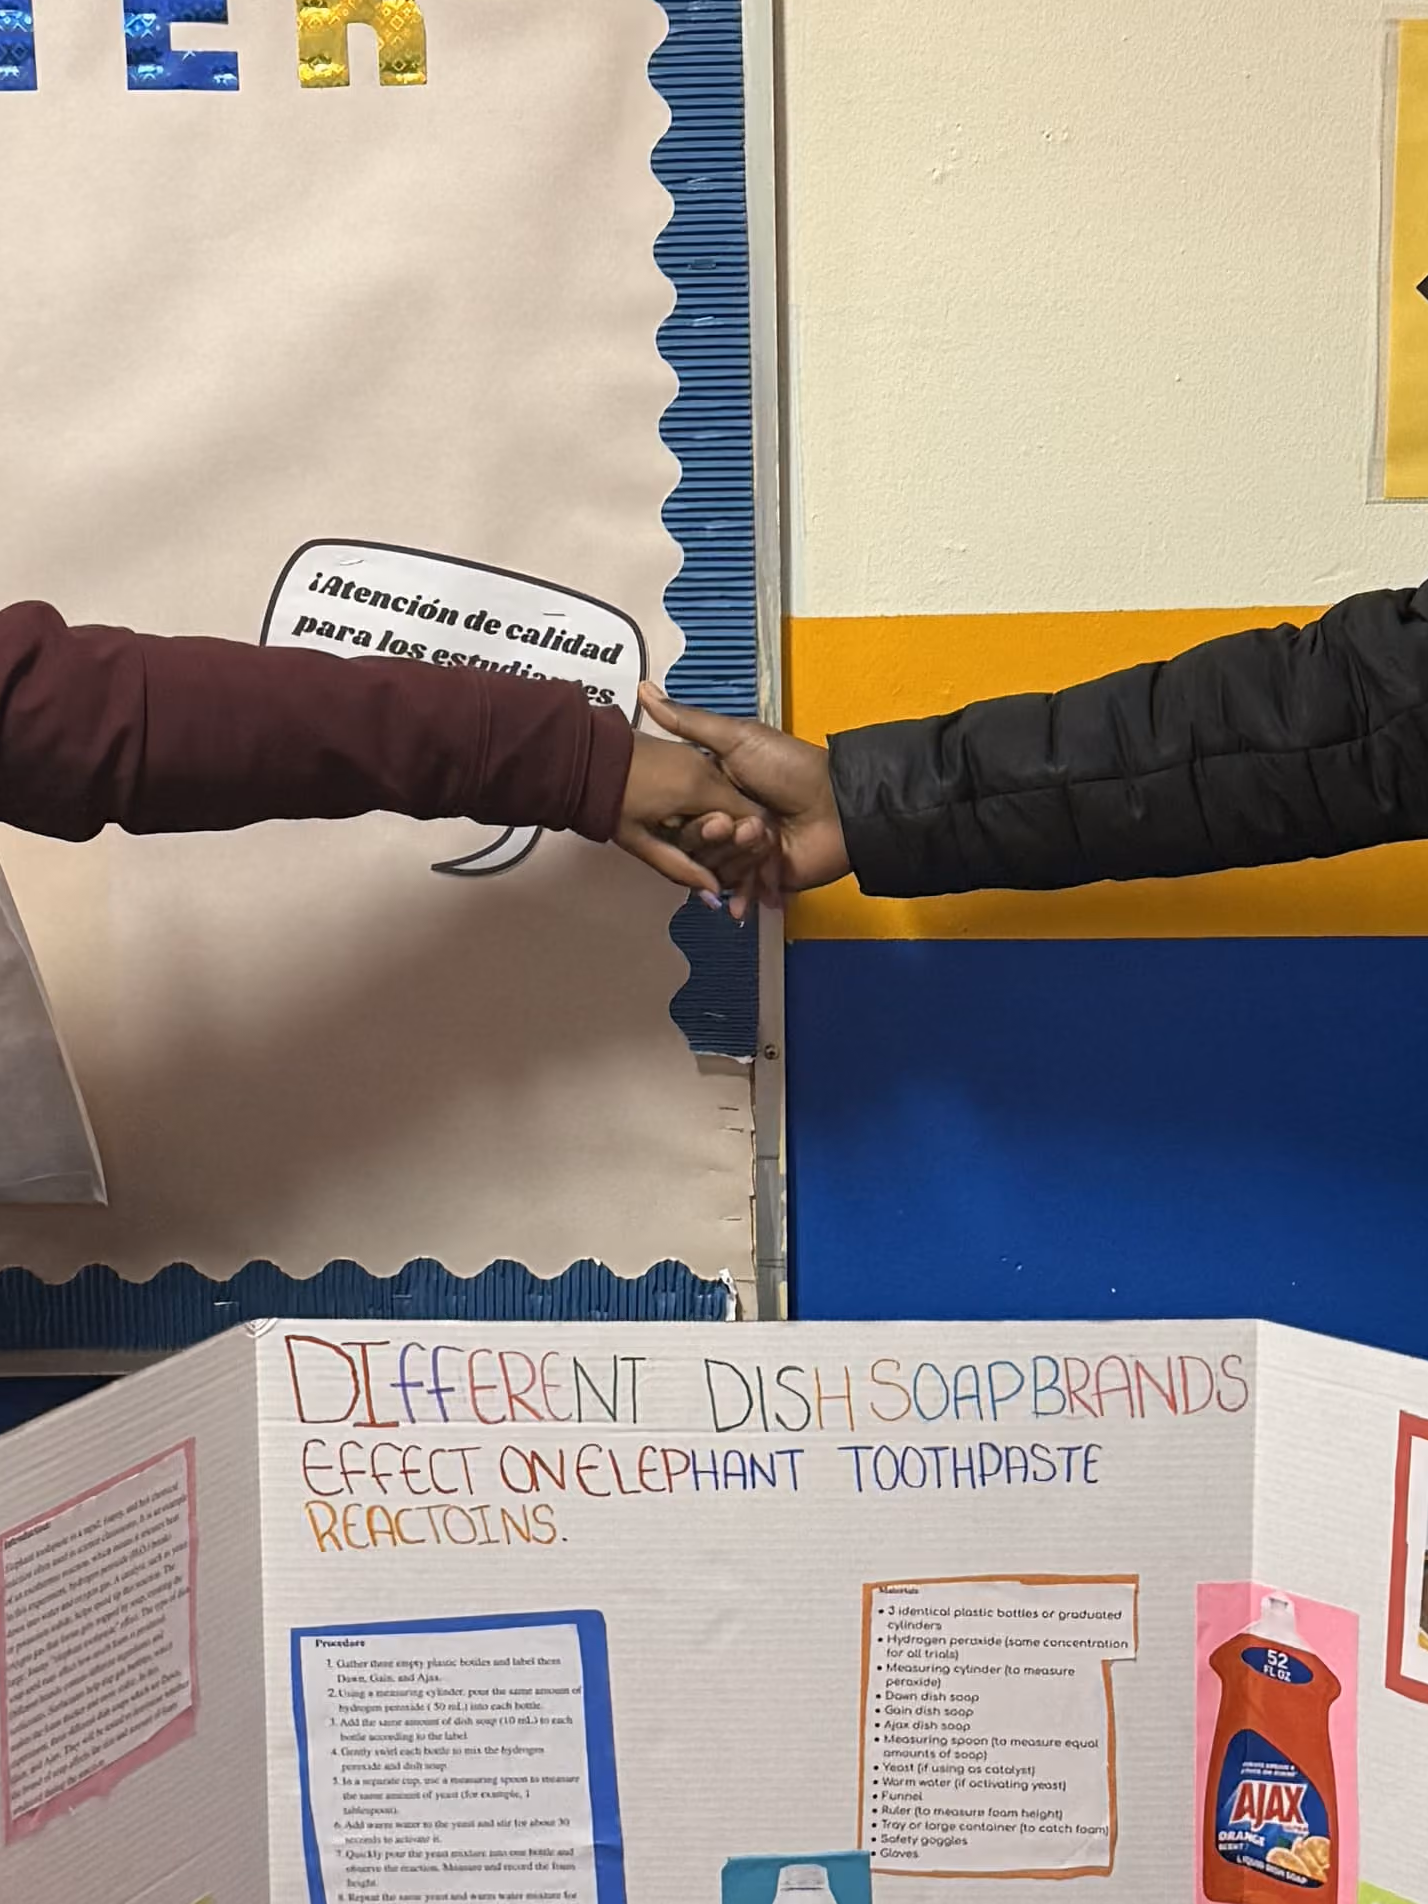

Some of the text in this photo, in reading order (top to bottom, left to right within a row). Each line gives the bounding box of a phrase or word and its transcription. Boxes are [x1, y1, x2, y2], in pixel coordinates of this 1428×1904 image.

[308, 571, 625, 665] ¡Atención de calidad
[291, 614, 372, 647] para
[377, 630, 428, 660] los
[837, 1441, 1103, 1493] TOOTHPASTE
[898, 1605, 951, 1617] identical
[953, 1608, 994, 1618] plastic
[997, 1608, 1039, 1619] bottles
[1041, 1610, 1054, 1619] or
[1058, 1610, 1123, 1621] graduated
[887, 1620, 942, 1631] cylinders
[886, 1634, 947, 1646] Hydrogen
[949, 1636, 1003, 1647] peroxide
[1043, 1637, 1129, 1649] concentration
[925, 1649, 959, 1660] trials)
[1267, 1650, 1288, 1670] 52
[886, 1663, 950, 1675] Measuring
[953, 1665, 1002, 1675] cylinder
[1024, 1666, 1075, 1676] measure
[1263, 1664, 1292, 1682] FL OZ
[920, 1691, 947, 1701] dish
[949, 1693, 980, 1704] soap
[884, 1705, 974, 1718] Gain dish soap
[912, 1720, 938, 1730] dish
[941, 1722, 971, 1732] soap
[1230, 1781, 1306, 1828] AJAX
[1218, 1830, 1266, 1847] ORANGE
